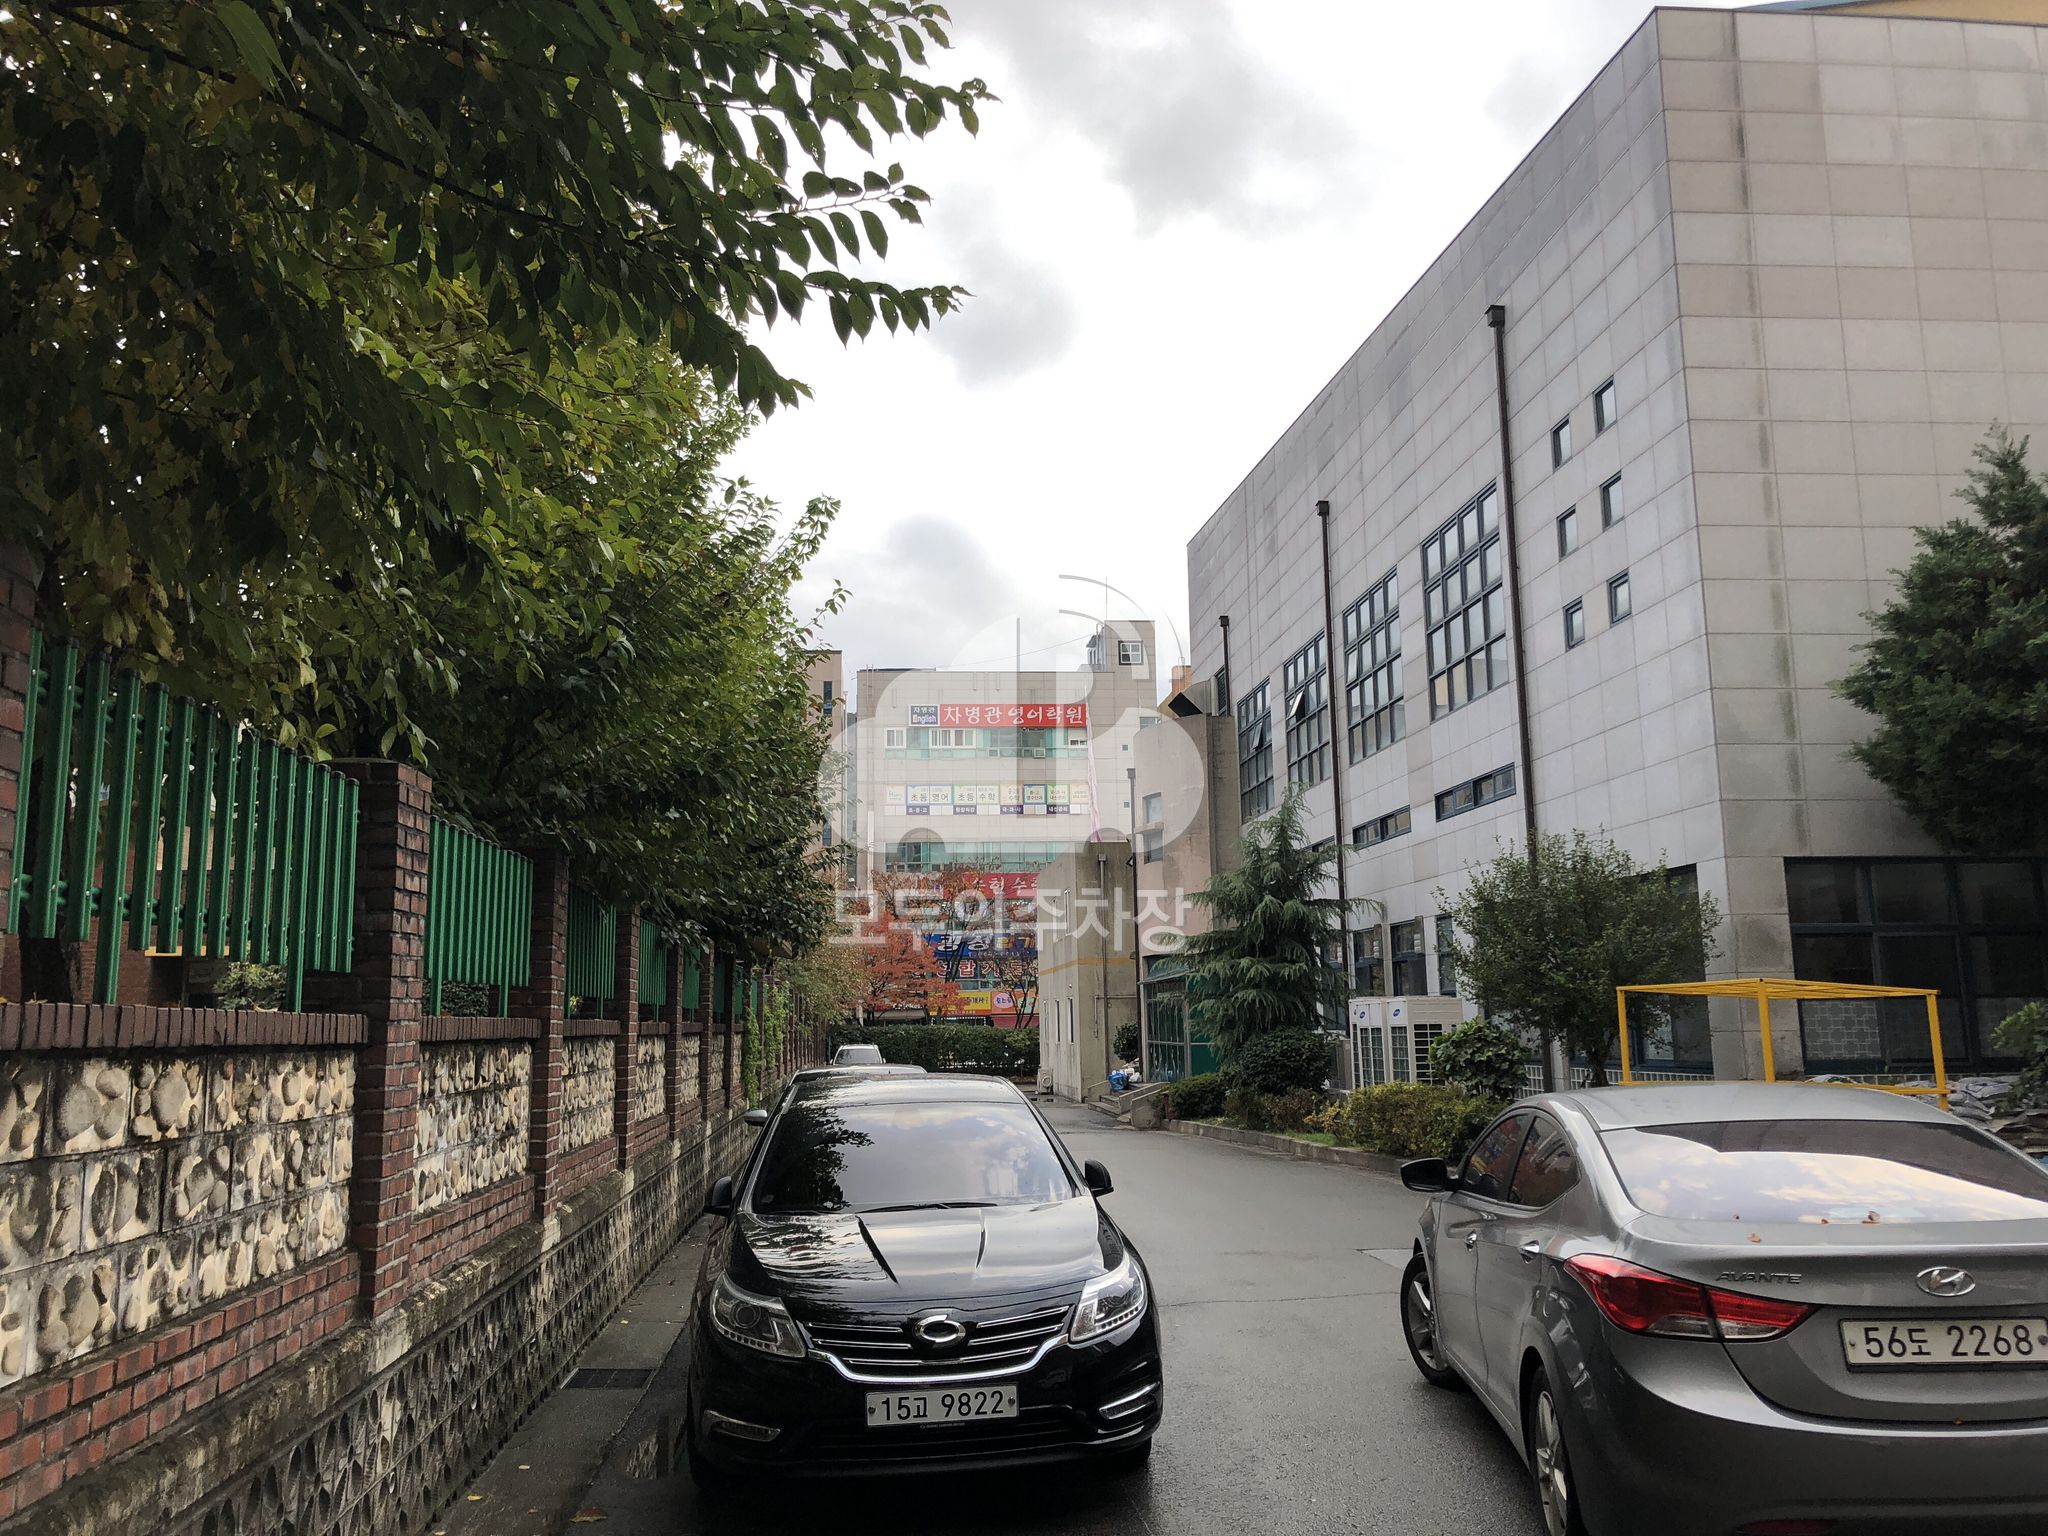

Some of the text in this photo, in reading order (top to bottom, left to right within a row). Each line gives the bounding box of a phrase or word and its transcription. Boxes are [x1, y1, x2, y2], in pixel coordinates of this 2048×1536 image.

[912, 713, 937, 724] English
[943, 705, 1083, 725] 차병관 영어학원
[1715, 1271, 1803, 1284] AVANTE
[1864, 1324, 2034, 1358] 56도 2268
[881, 1390, 1004, 1421] 15고 9822
